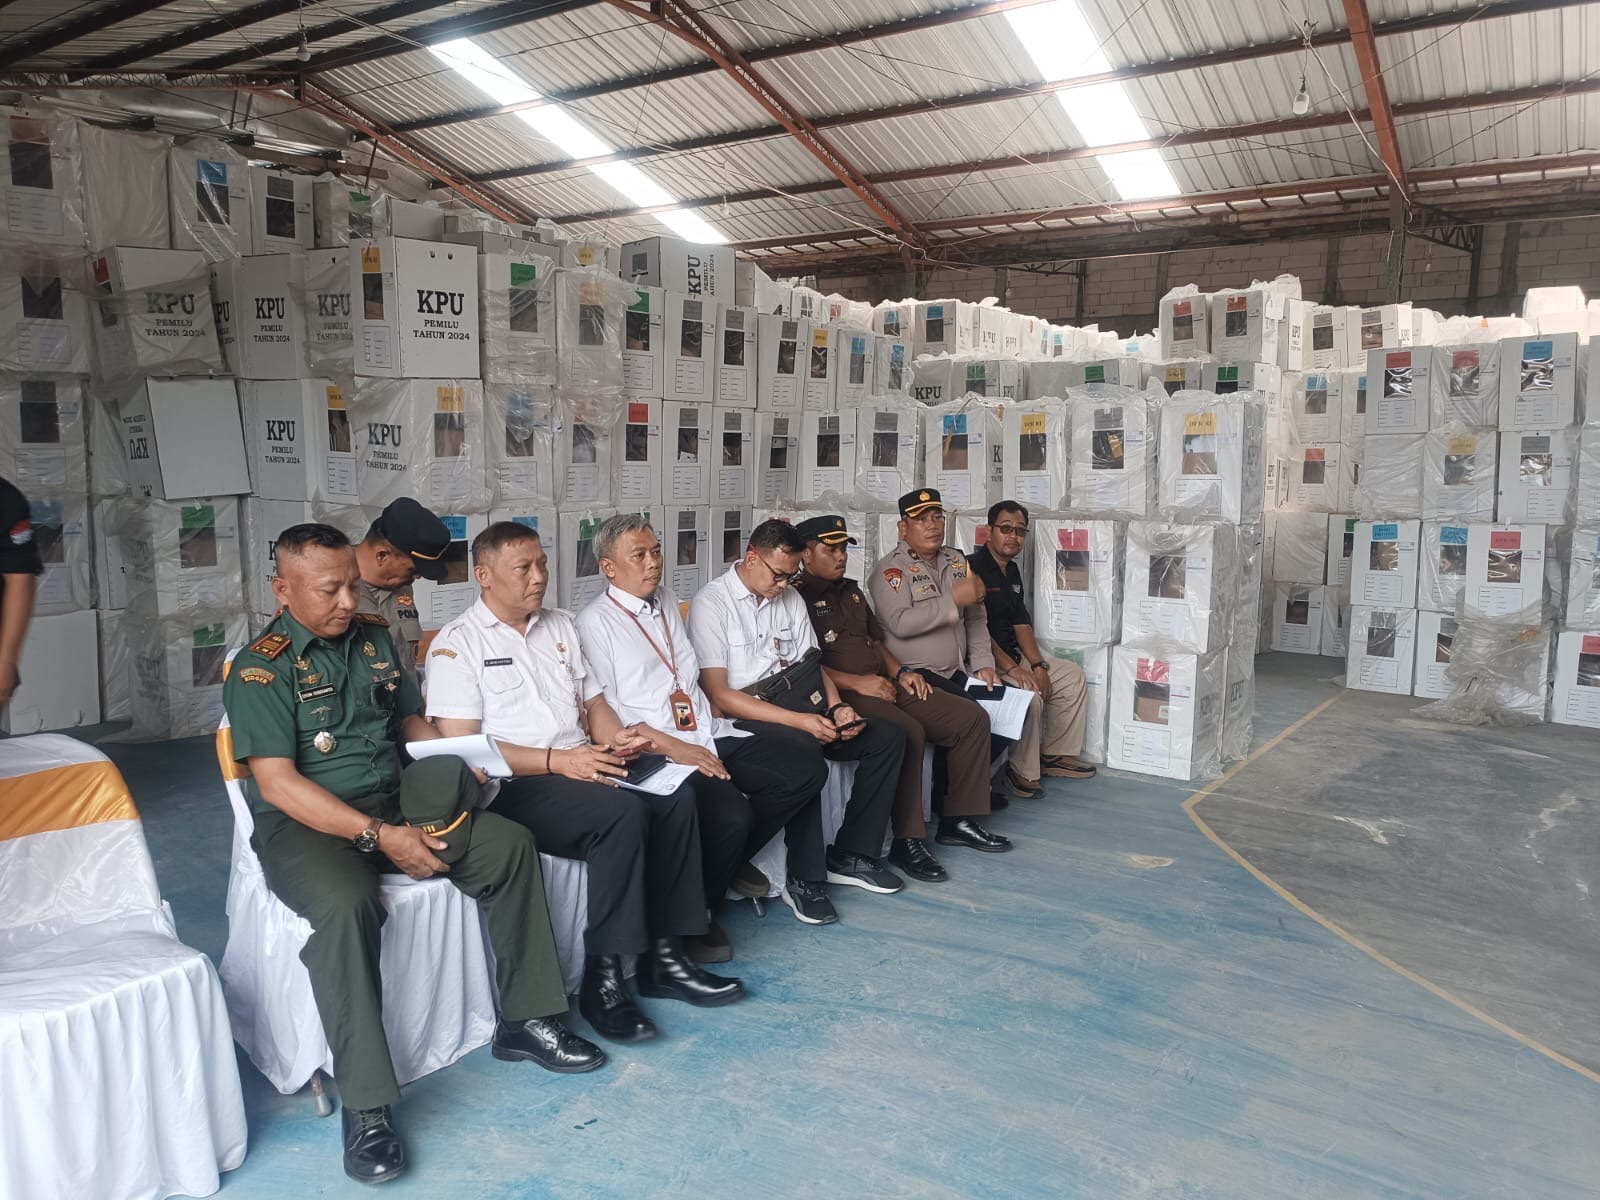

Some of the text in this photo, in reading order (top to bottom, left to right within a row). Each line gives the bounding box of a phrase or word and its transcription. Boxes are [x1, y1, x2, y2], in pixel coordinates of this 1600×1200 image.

[687, 254, 701, 295] KPU
[144, 292, 195, 315] KPU
[254, 297, 285, 319] KPU
[316, 293, 351, 317] KPU
[417, 289, 464, 316] KPU
[155, 319, 193, 327] PEMILU
[260, 324, 283, 332] PEMILU
[424, 319, 459, 329] PEMILU
[145, 328, 206, 337] TAHUN 2024
[413, 330, 470, 340] TAHUN 2024
[253, 334, 290, 343] TAHUN 2024
[915, 386, 942, 399] KPU
[266, 419, 295, 441] KPU
[367, 422, 402, 447] KPU
[129, 437, 149, 460] KPU
[271, 446, 294, 454] PEMILU
[265, 455, 300, 464] TAHUN 2024
[373, 450, 399, 460] PEMILU
[366, 460, 407, 471] TAHUN 2024
